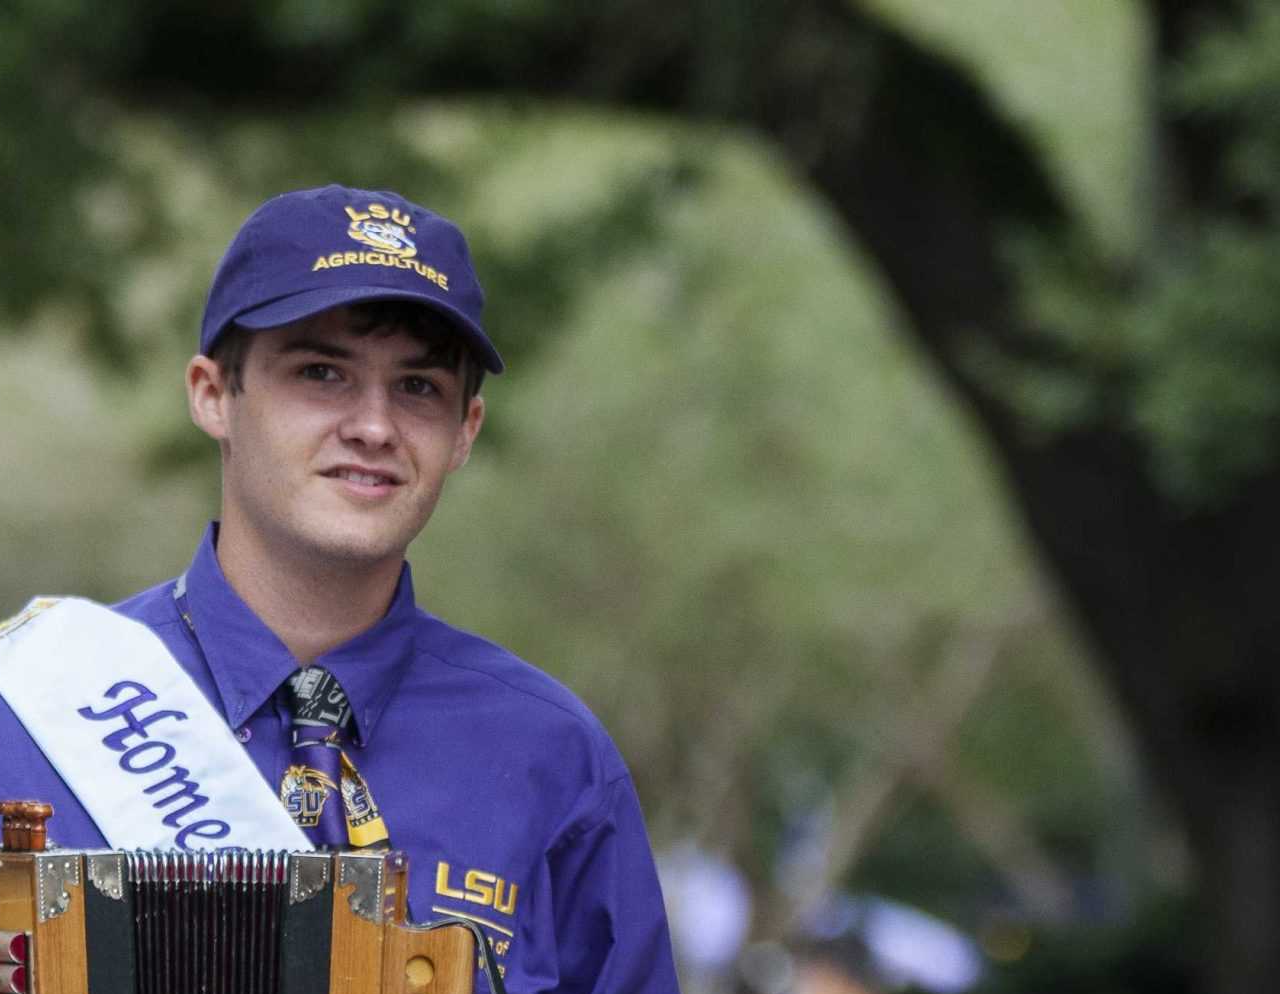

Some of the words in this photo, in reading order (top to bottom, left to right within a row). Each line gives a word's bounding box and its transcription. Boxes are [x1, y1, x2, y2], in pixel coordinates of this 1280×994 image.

[344, 203, 411, 226] LSU
[312, 251, 449, 291] AGRICULTURE
[318, 680, 348, 725] LS
[77, 680, 248, 856] Home
[435, 861, 519, 915] LSU
[495, 940, 511, 956] of
